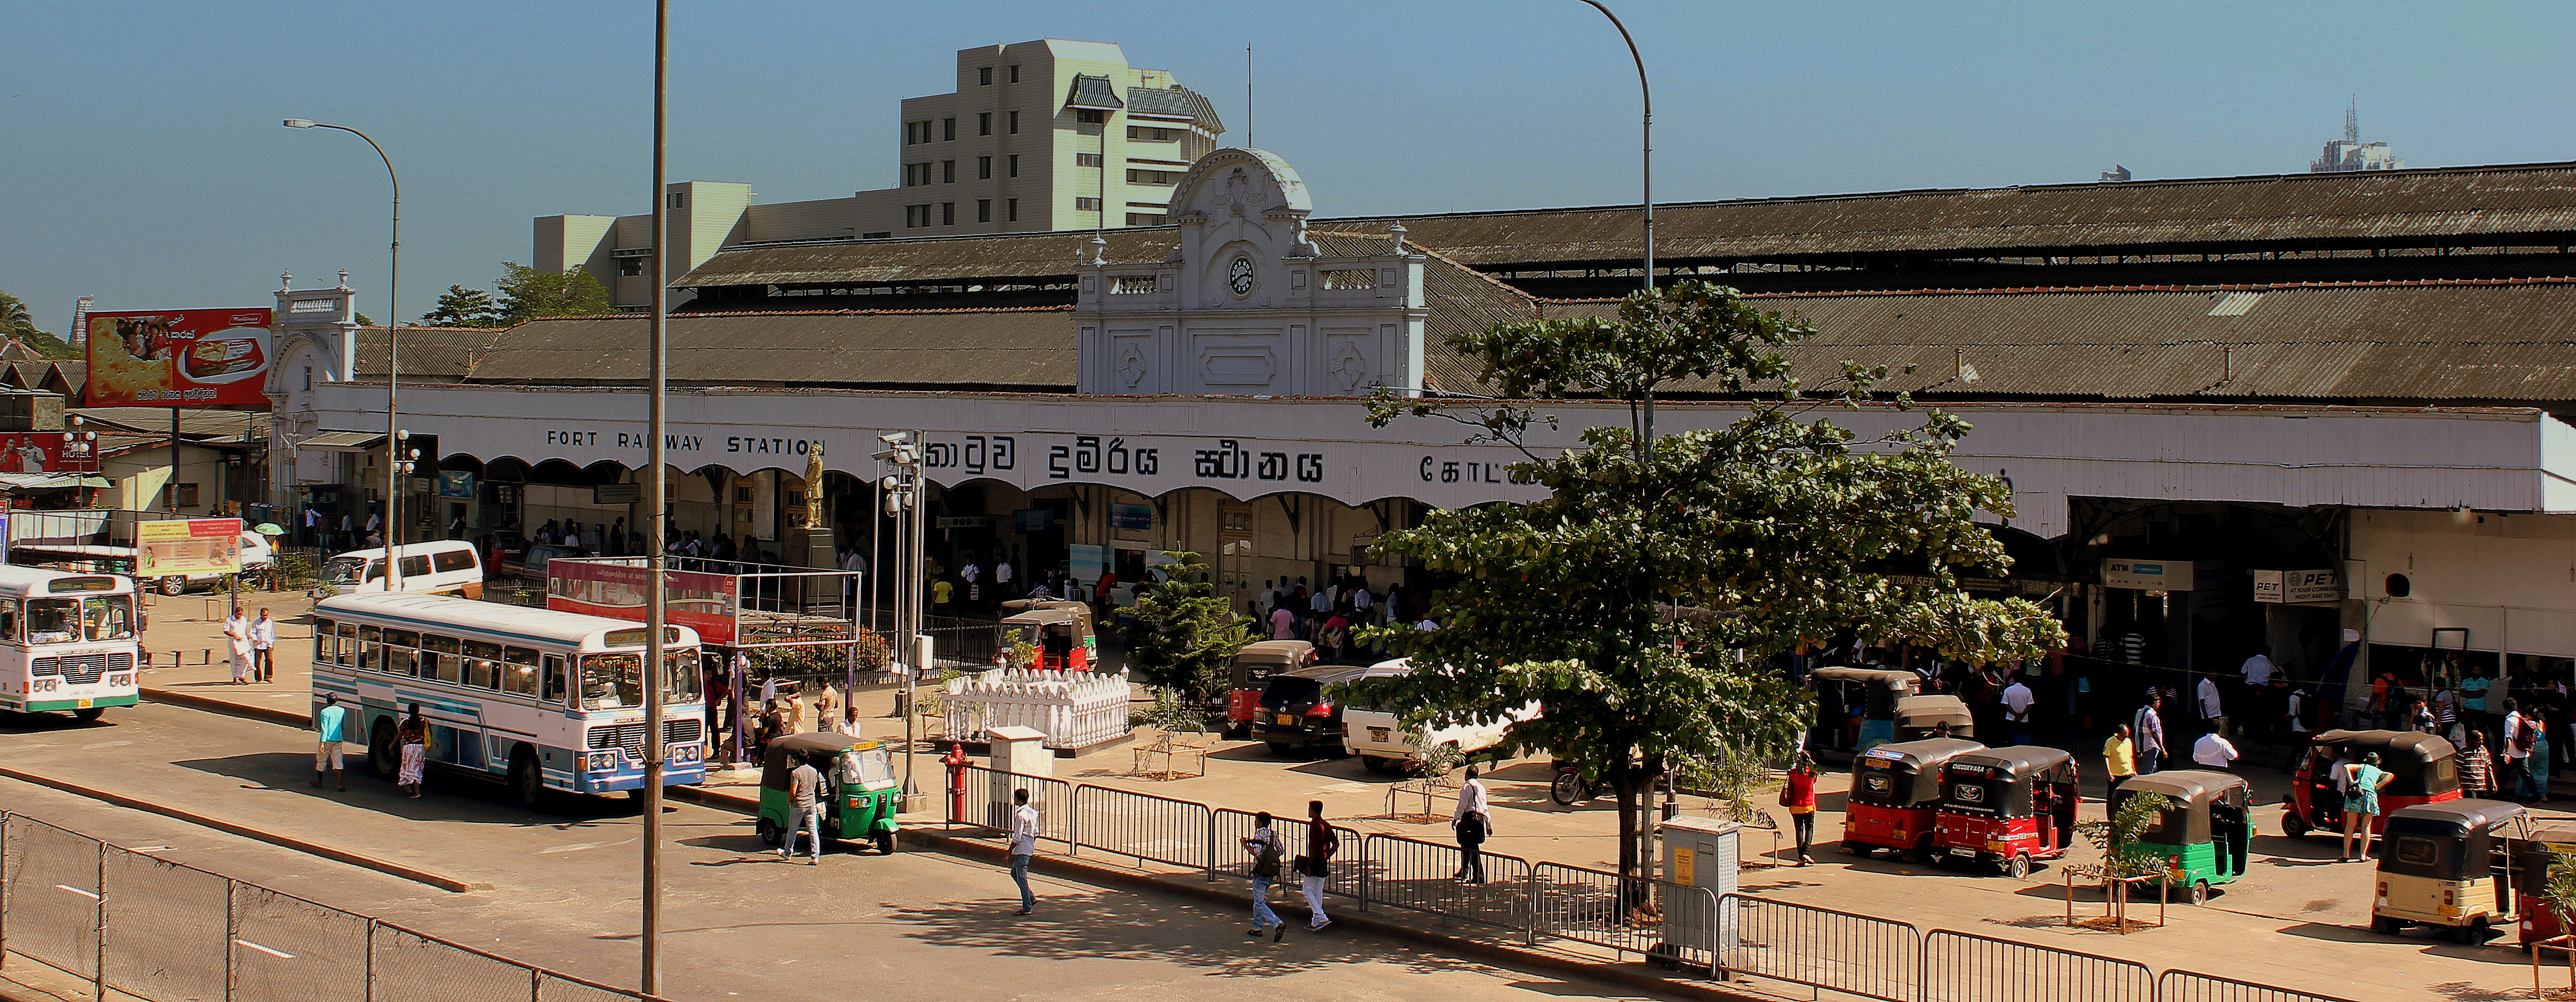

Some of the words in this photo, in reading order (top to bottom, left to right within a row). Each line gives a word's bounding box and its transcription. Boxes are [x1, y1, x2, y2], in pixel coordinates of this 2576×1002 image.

[547, 429, 598, 447] FORT
[617, 432, 704, 451] RAIWAY
[1049, 435, 1159, 479] දුම්රිය
[2303, 573, 2337, 586] PET
[2027, 584, 2047, 593] RAIL
[2256, 583, 2279, 591] PET
